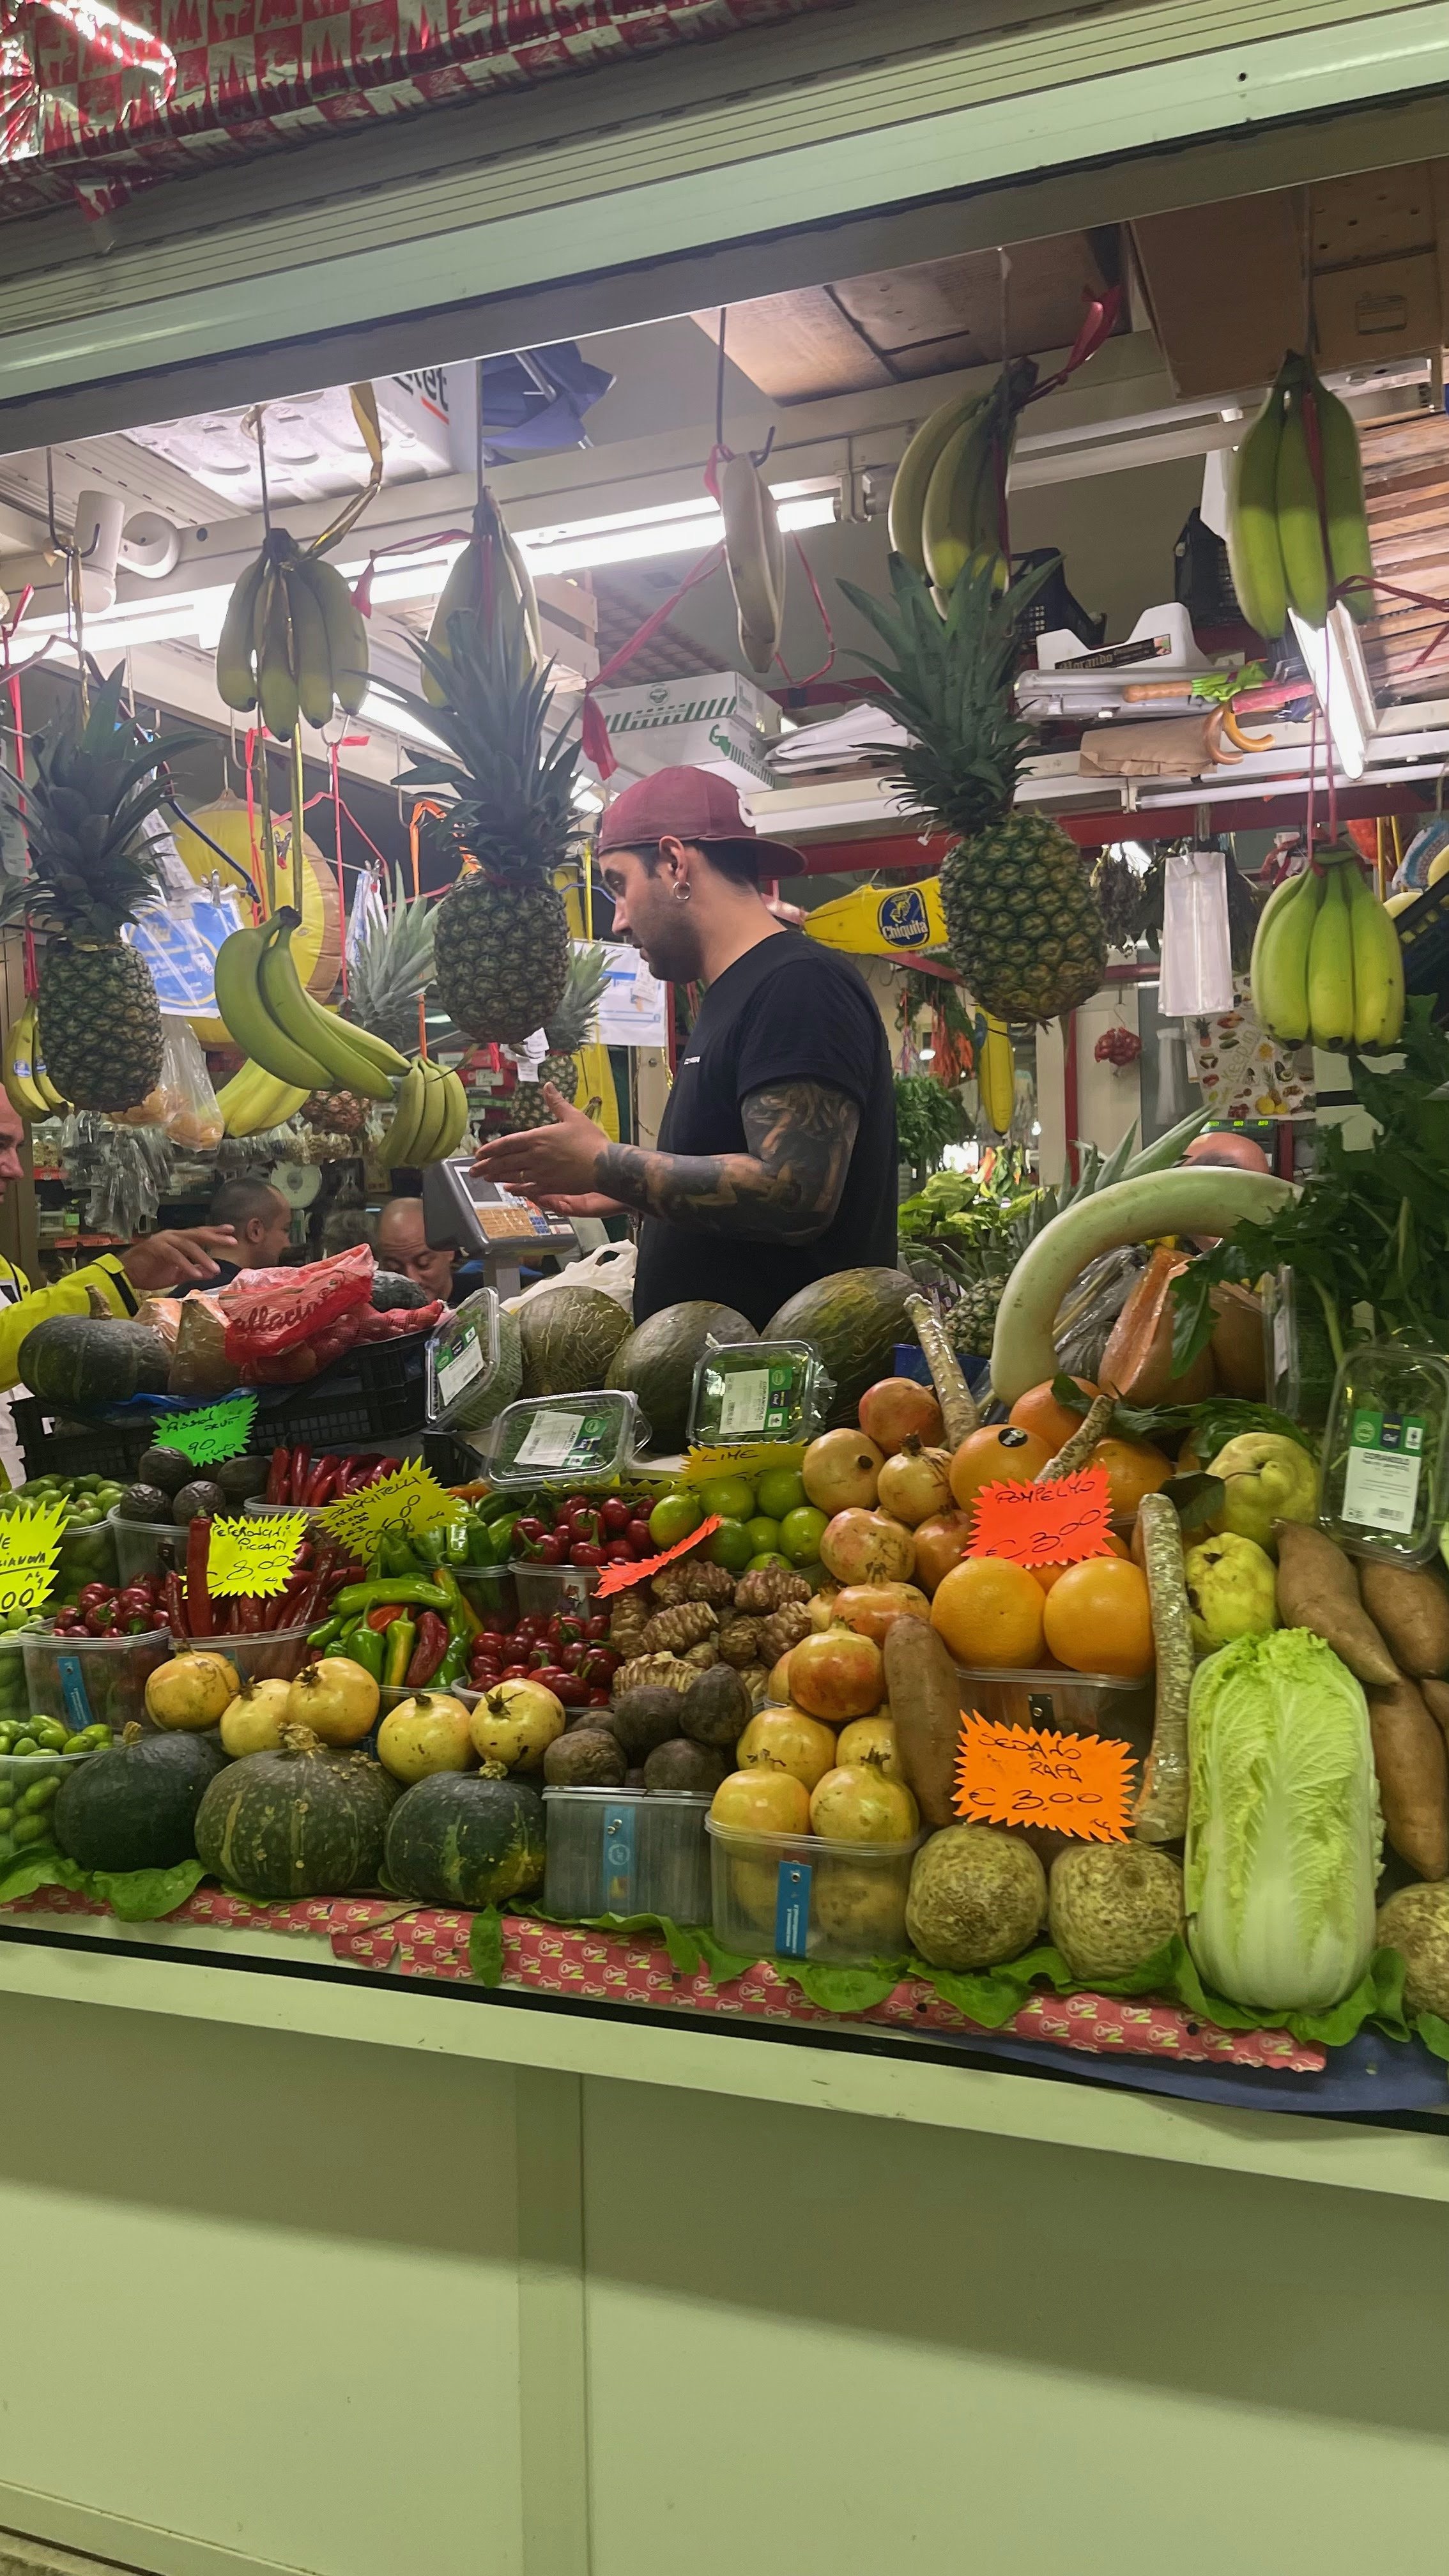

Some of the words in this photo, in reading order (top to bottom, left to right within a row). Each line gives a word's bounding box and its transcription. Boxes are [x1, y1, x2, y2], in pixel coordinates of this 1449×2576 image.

[882, 920, 928, 940] Chiquita
[701, 1449, 759, 1462] LIME
[1028, 1761, 1083, 1783] RAPA
